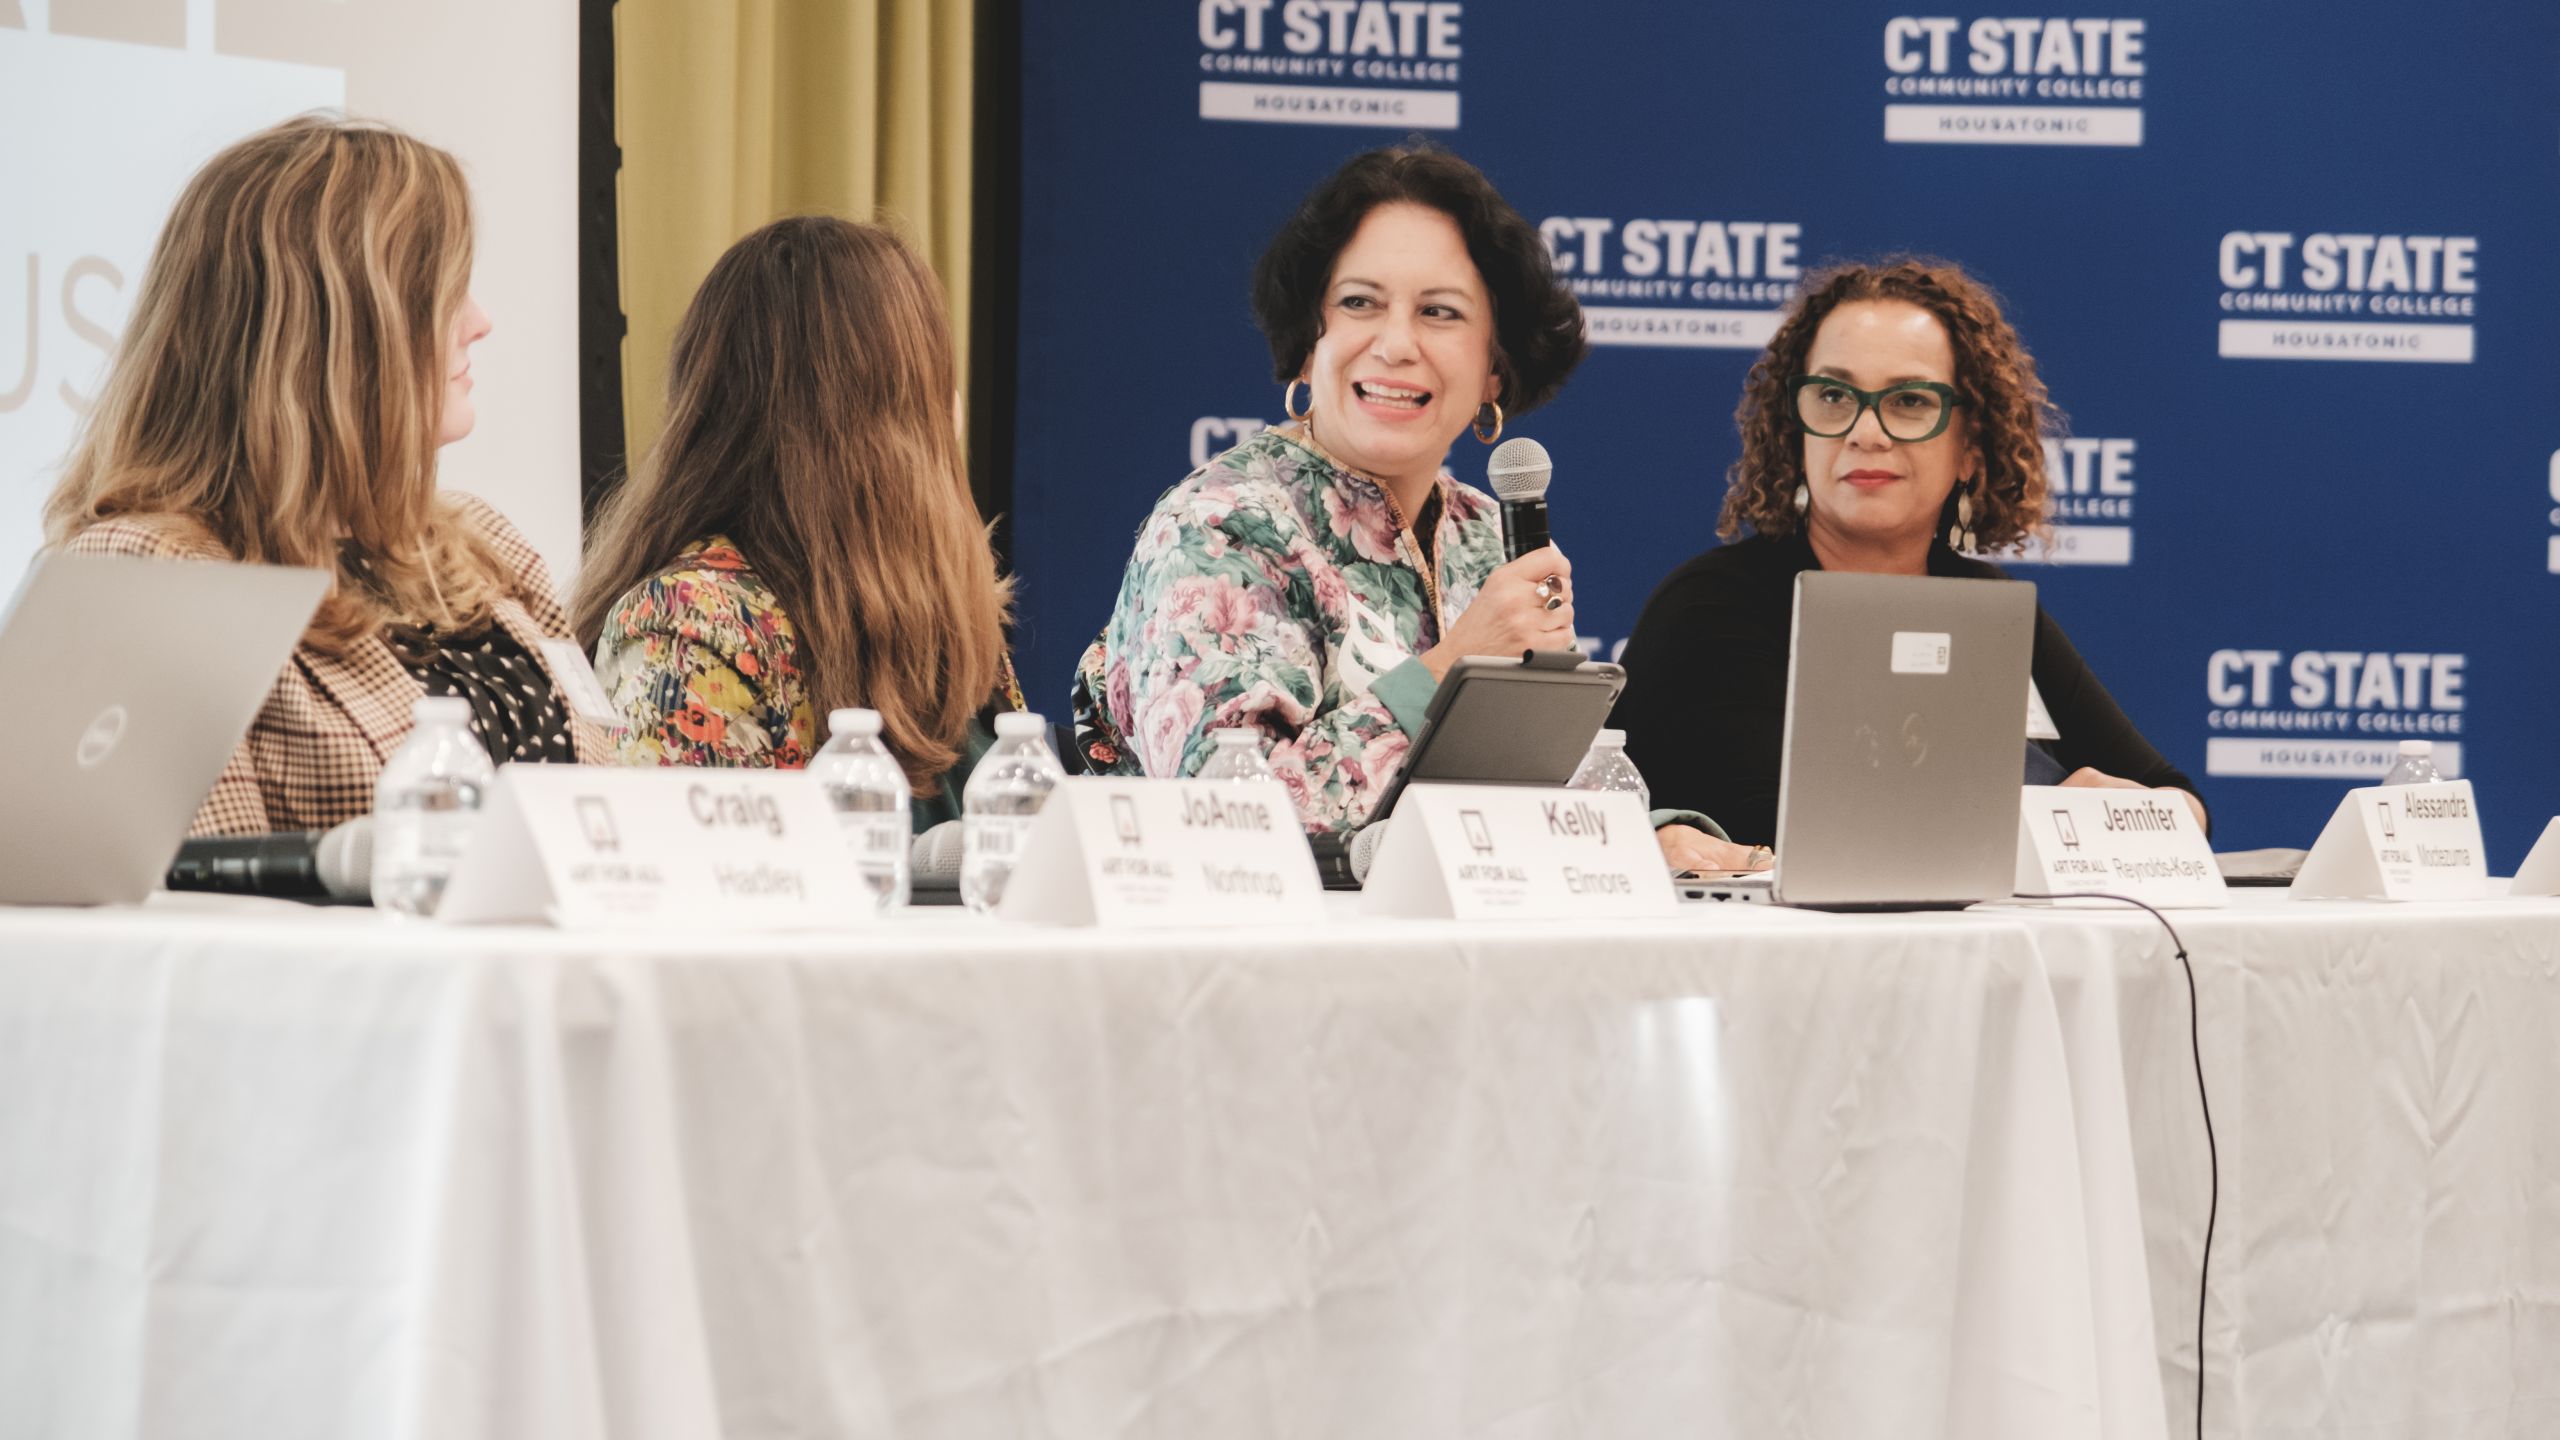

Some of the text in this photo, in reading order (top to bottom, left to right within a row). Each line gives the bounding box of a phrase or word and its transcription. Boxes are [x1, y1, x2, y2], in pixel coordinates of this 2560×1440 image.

[1199, 0, 1462, 58] CT STATE
[1884, 16, 2145, 76] CT STATE
[1200, 54, 1459, 81] COMMUNITY COLLEGE
[1885, 77, 2143, 99] COMMUNITY COLLEGE
[1253, 94, 1406, 115] HOUSATONIC
[1939, 115, 2089, 134] HOUSATONIC
[1538, 216, 1801, 279] CT STATE
[2219, 230, 2477, 293] CT STATE
[1690, 281, 1798, 301] COLLEGE
[2219, 291, 2474, 316] COMMUNITY COLLEGE
[1592, 317, 1743, 337] HOUSATONIC
[2272, 331, 2422, 349] HOUSATONIC
[2040, 437, 2136, 495] ATE
[2207, 649, 2465, 711] CT STATE
[2207, 710, 2462, 733] COMMUNITY COLLEGE
[687, 784, 784, 837] Craig
[1181, 787, 1272, 832] JoAnne
[2104, 800, 2178, 832] Jennifer
[2405, 792, 2469, 818] Alessandra
[1541, 800, 1608, 845] Kelly
[1562, 866, 1632, 894] Elmore
[2112, 857, 2208, 883] Reynolds-Kaye
